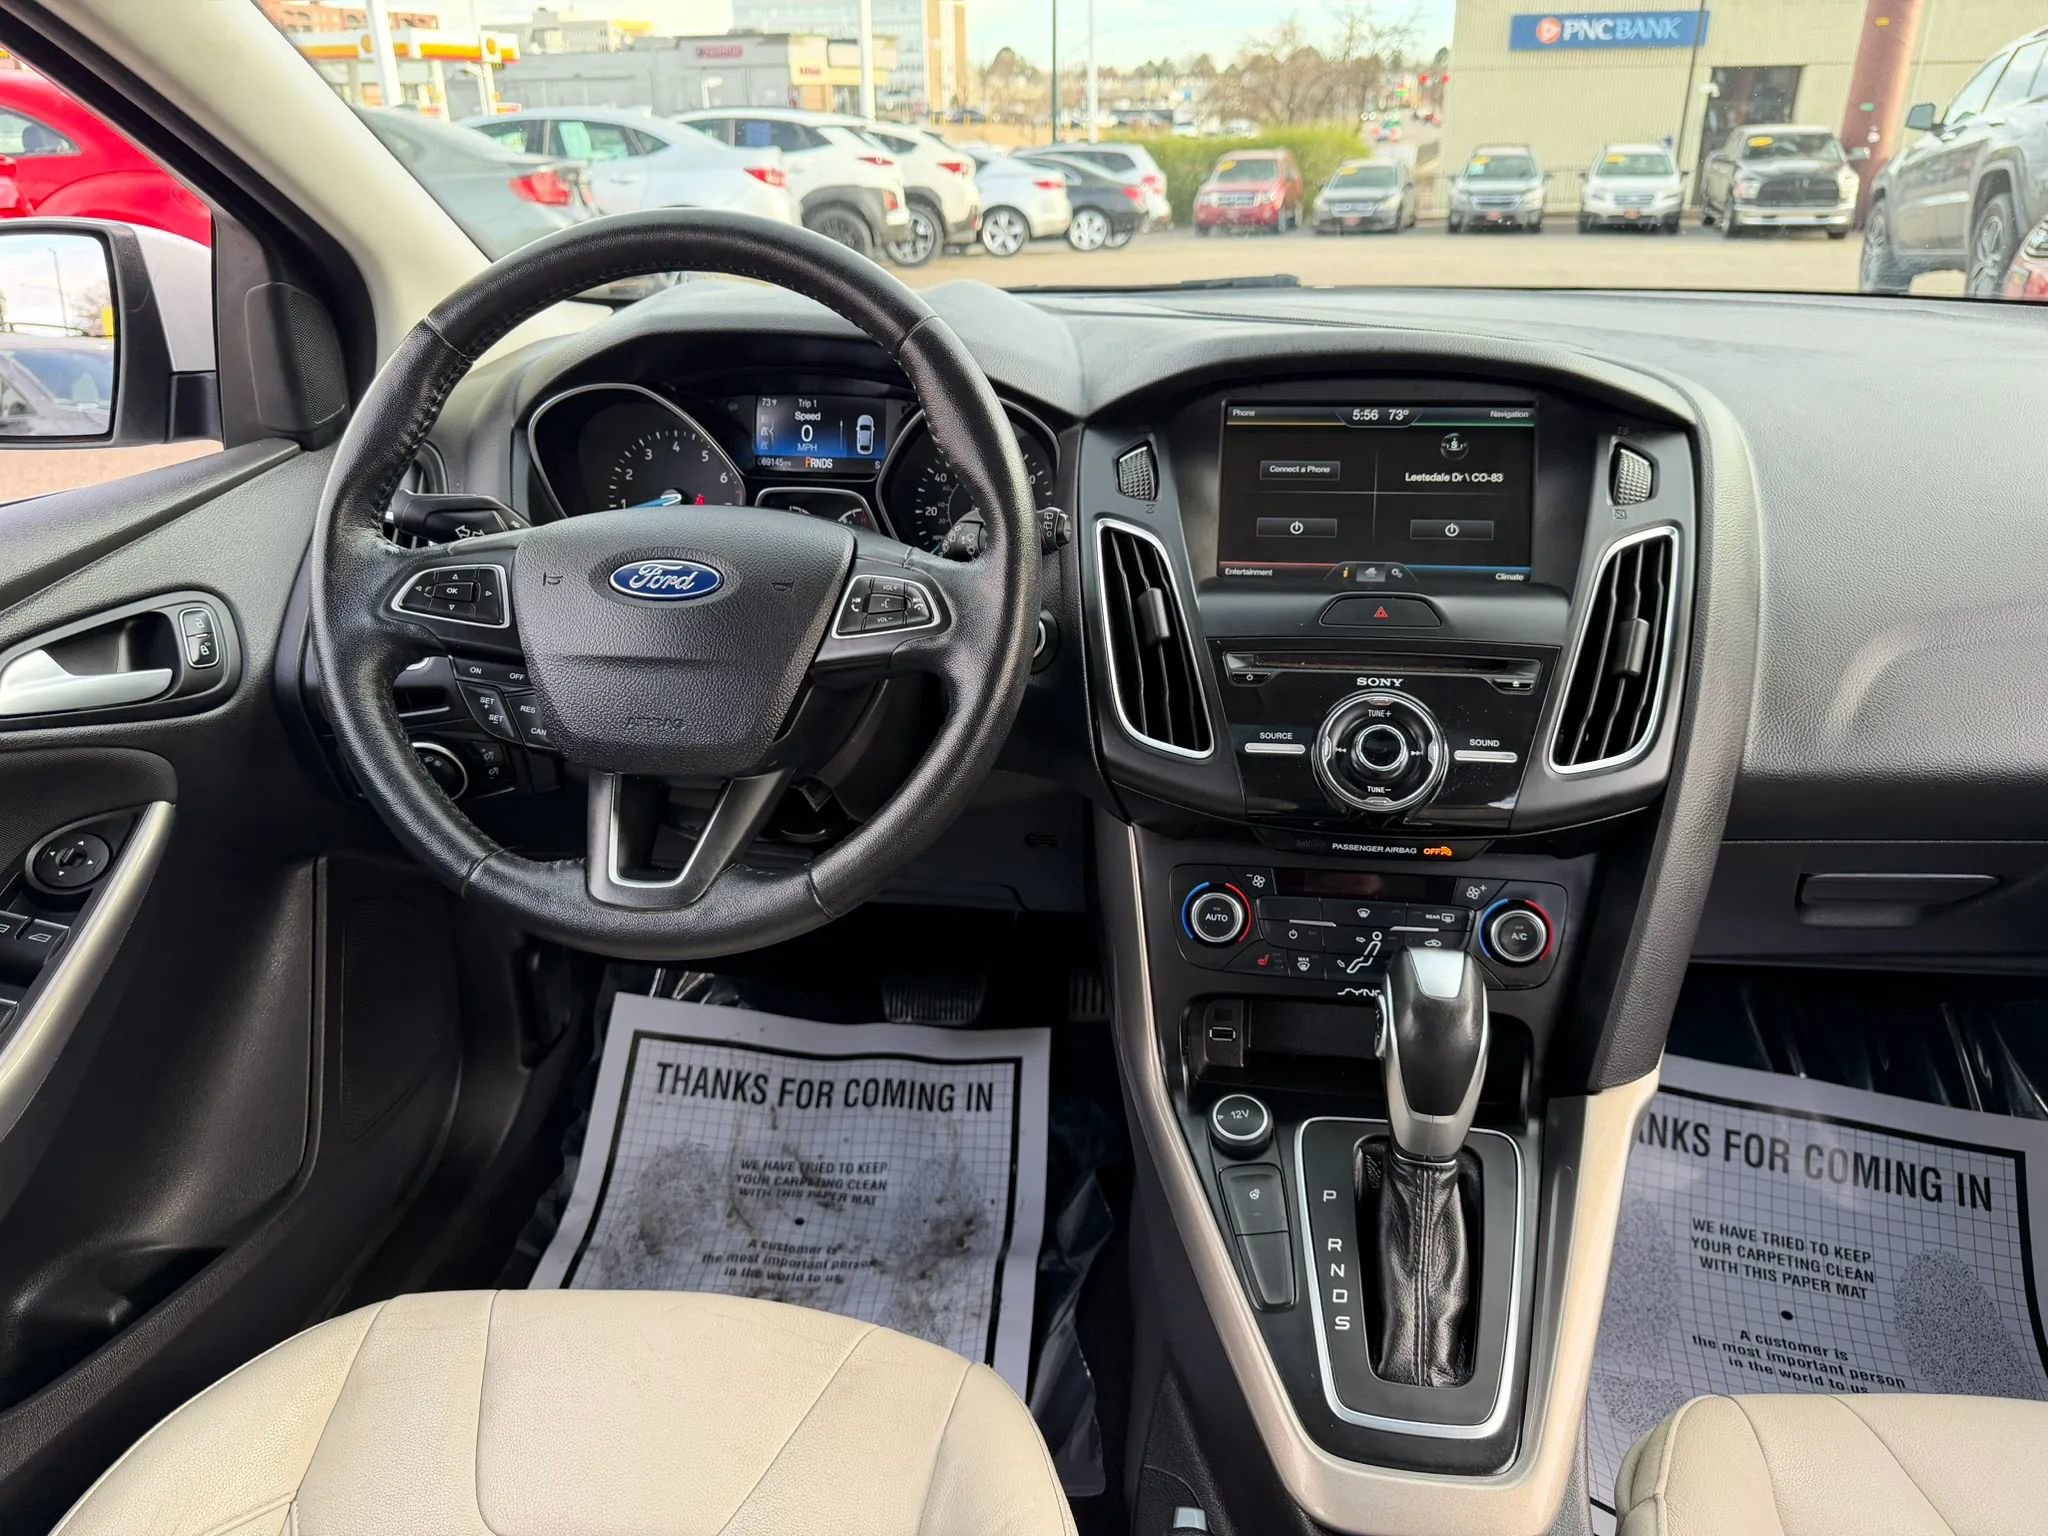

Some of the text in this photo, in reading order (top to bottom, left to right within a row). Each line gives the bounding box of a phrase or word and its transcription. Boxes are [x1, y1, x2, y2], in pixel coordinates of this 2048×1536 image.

[798, 398, 812, 409] Trip
[794, 411, 821, 422] Speed
[1232, 409, 1255, 417] Phone
[1352, 409, 1379, 420] 5:56
[1490, 410, 1529, 419] Navigation
[801, 424, 813, 442] 0
[672, 441, 680, 453] 4
[797, 443, 818, 452] MPH
[644, 449, 653, 460] 3
[701, 451, 709, 462] 5
[625, 469, 633, 480] 2
[1269, 465, 1300, 473] Connect
[1307, 466, 1330, 474] Phone
[719, 472, 728, 484] 6
[934, 473, 947, 483] 40
[1405, 472, 1450, 482] Leetsdale
[1452, 473, 1464, 482] Dr
[1471, 473, 1504, 482] CO-83
[925, 506, 938, 516] 20
[1224, 567, 1273, 576] Entertainment
[1495, 572, 1524, 582] Climate
[629, 564, 698, 591] Ford
[446, 587, 458, 595] OK
[469, 666, 482, 675] ON
[509, 672, 525, 681] OFF
[1356, 677, 1404, 687] SONY
[480, 697, 495, 705] SET
[520, 705, 536, 714] RES
[488, 714, 503, 722] SET
[530, 727, 547, 736] CAN
[1259, 732, 1293, 740] SOURCE
[1469, 738, 1500, 748] SOUND
[1332, 843, 1384, 854] PASSENGER
[1384, 846, 1417, 855] AIRBAG
[1423, 847, 1441, 855] OFF
[1205, 912, 1228, 922] AUTO
[1511, 932, 1528, 941] A/C
[657, 1061, 993, 1112] THANKS FOR COMING IN
[1230, 1109, 1249, 1120] 12V
[740, 1159, 759, 1170] WE
[762, 1160, 795, 1172] HAVE
[839, 1162, 854, 1174] TO
[857, 1162, 888, 1174] KEEP
[1638, 1112, 1992, 1212] NKS FOR COMING IN
[736, 1174, 770, 1186] YOUR
[847, 1179, 888, 1191] CLEAN
[738, 1187, 877, 1206] WITH THIS PAPER MAT
[1323, 1189, 1337, 1202] P
[1327, 1238, 1343, 1252] R
[1692, 1217, 1871, 1264] WE HAVE TRIED TO KEEP
[748, 1239, 757, 1249] A
[761, 1241, 823, 1255] customer
[702, 1253, 722, 1264] the
[726, 1253, 759, 1264] most
[763, 1254, 828, 1271] important
[1691, 1236, 1875, 1284] YOUR CARPETING CLEAN
[724, 1266, 736, 1277] in
[740, 1267, 762, 1279] the
[767, 1270, 804, 1283] world
[808, 1273, 821, 1283] to
[1330, 1263, 1345, 1278] N
[1699, 1256, 1868, 1300] WITH THIS PAPER MAT
[1332, 1289, 1348, 1304] D
[1334, 1316, 1351, 1330] S
[1740, 1330, 1848, 1361] A customer is
[1692, 1335, 1906, 1389] the most important person
[1728, 1357, 1869, 1393] in the world to us
